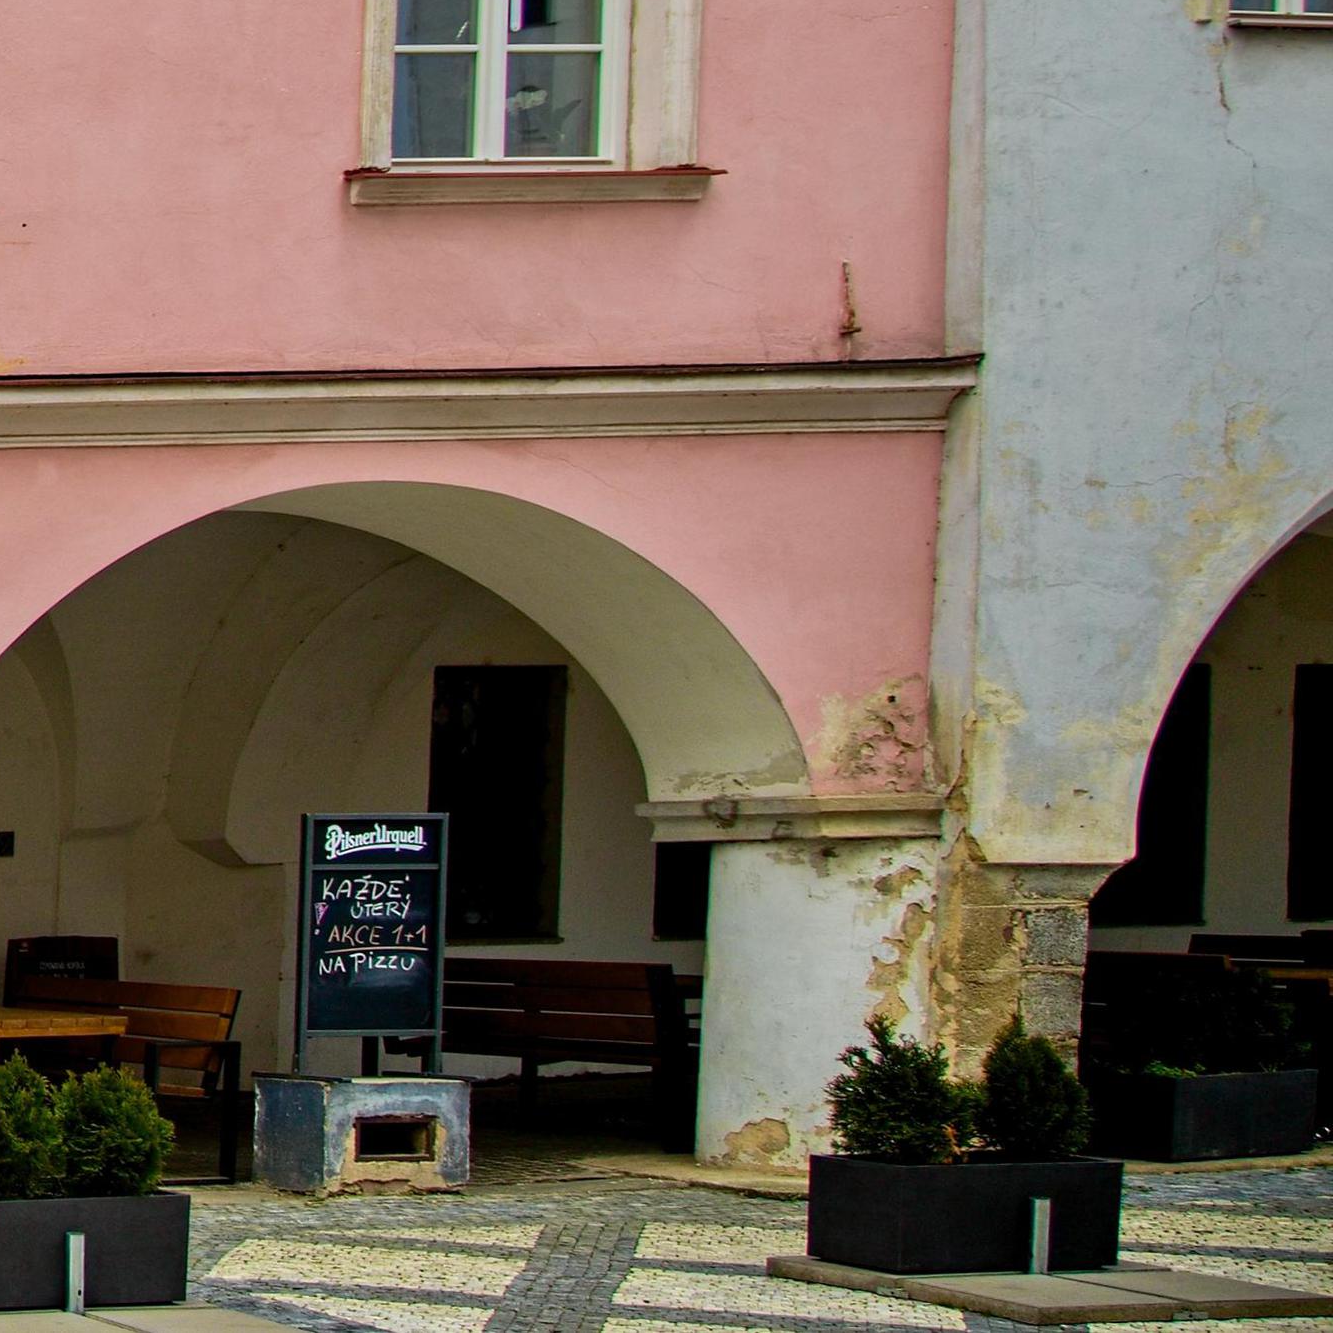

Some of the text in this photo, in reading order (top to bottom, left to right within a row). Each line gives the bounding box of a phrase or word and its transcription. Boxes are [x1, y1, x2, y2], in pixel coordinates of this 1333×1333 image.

[324, 823, 424, 860] Pilsner Urquell
[327, 924, 427, 946] AKCE 1+1
[319, 956, 347, 975] NA
